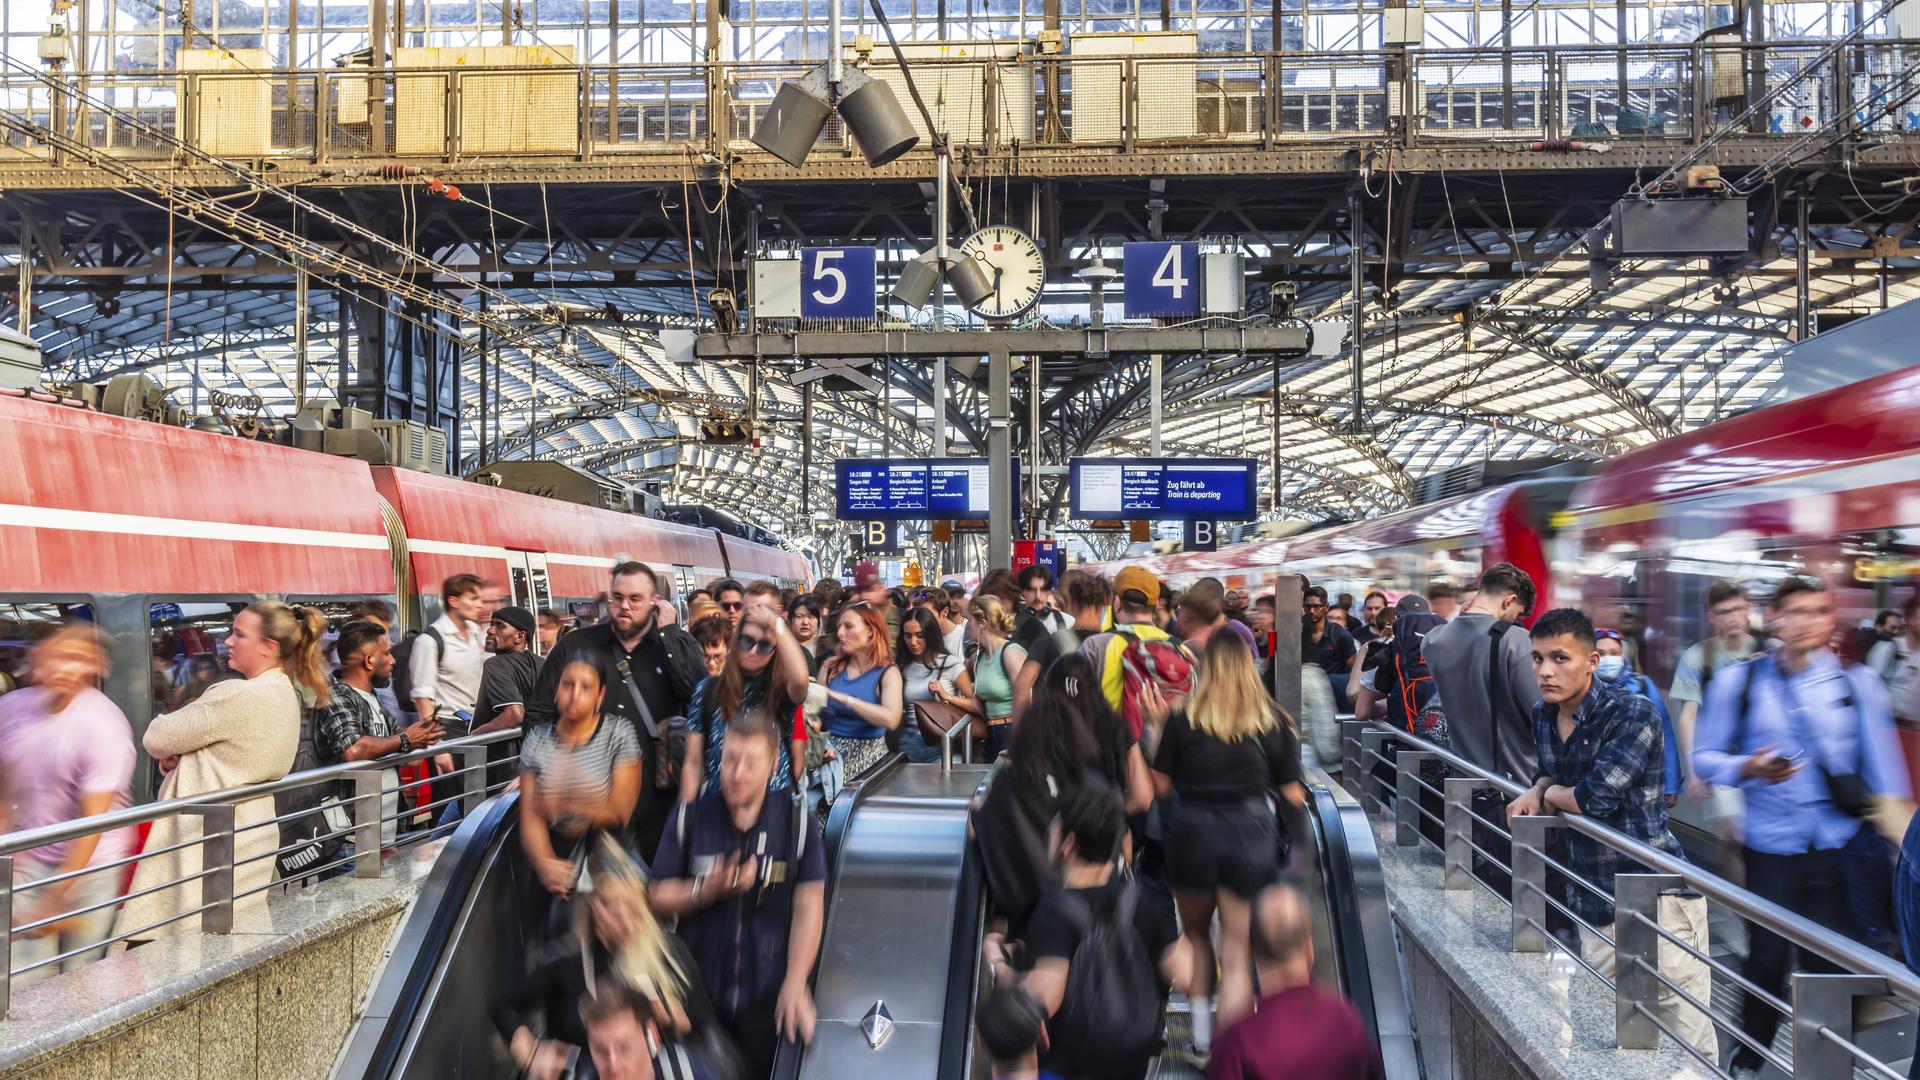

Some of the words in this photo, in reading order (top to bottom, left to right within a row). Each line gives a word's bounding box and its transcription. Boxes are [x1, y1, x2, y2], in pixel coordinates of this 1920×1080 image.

[812, 250, 847, 305] 5
[1152, 245, 1189, 299] 4
[1167, 481, 1179, 490] Zug
[1180, 480, 1196, 488] fährt
[1190, 490, 1221, 500] departing
[869, 520, 886, 544] B
[1196, 520, 1212, 544] B
[282, 845, 320, 871] PUMA
